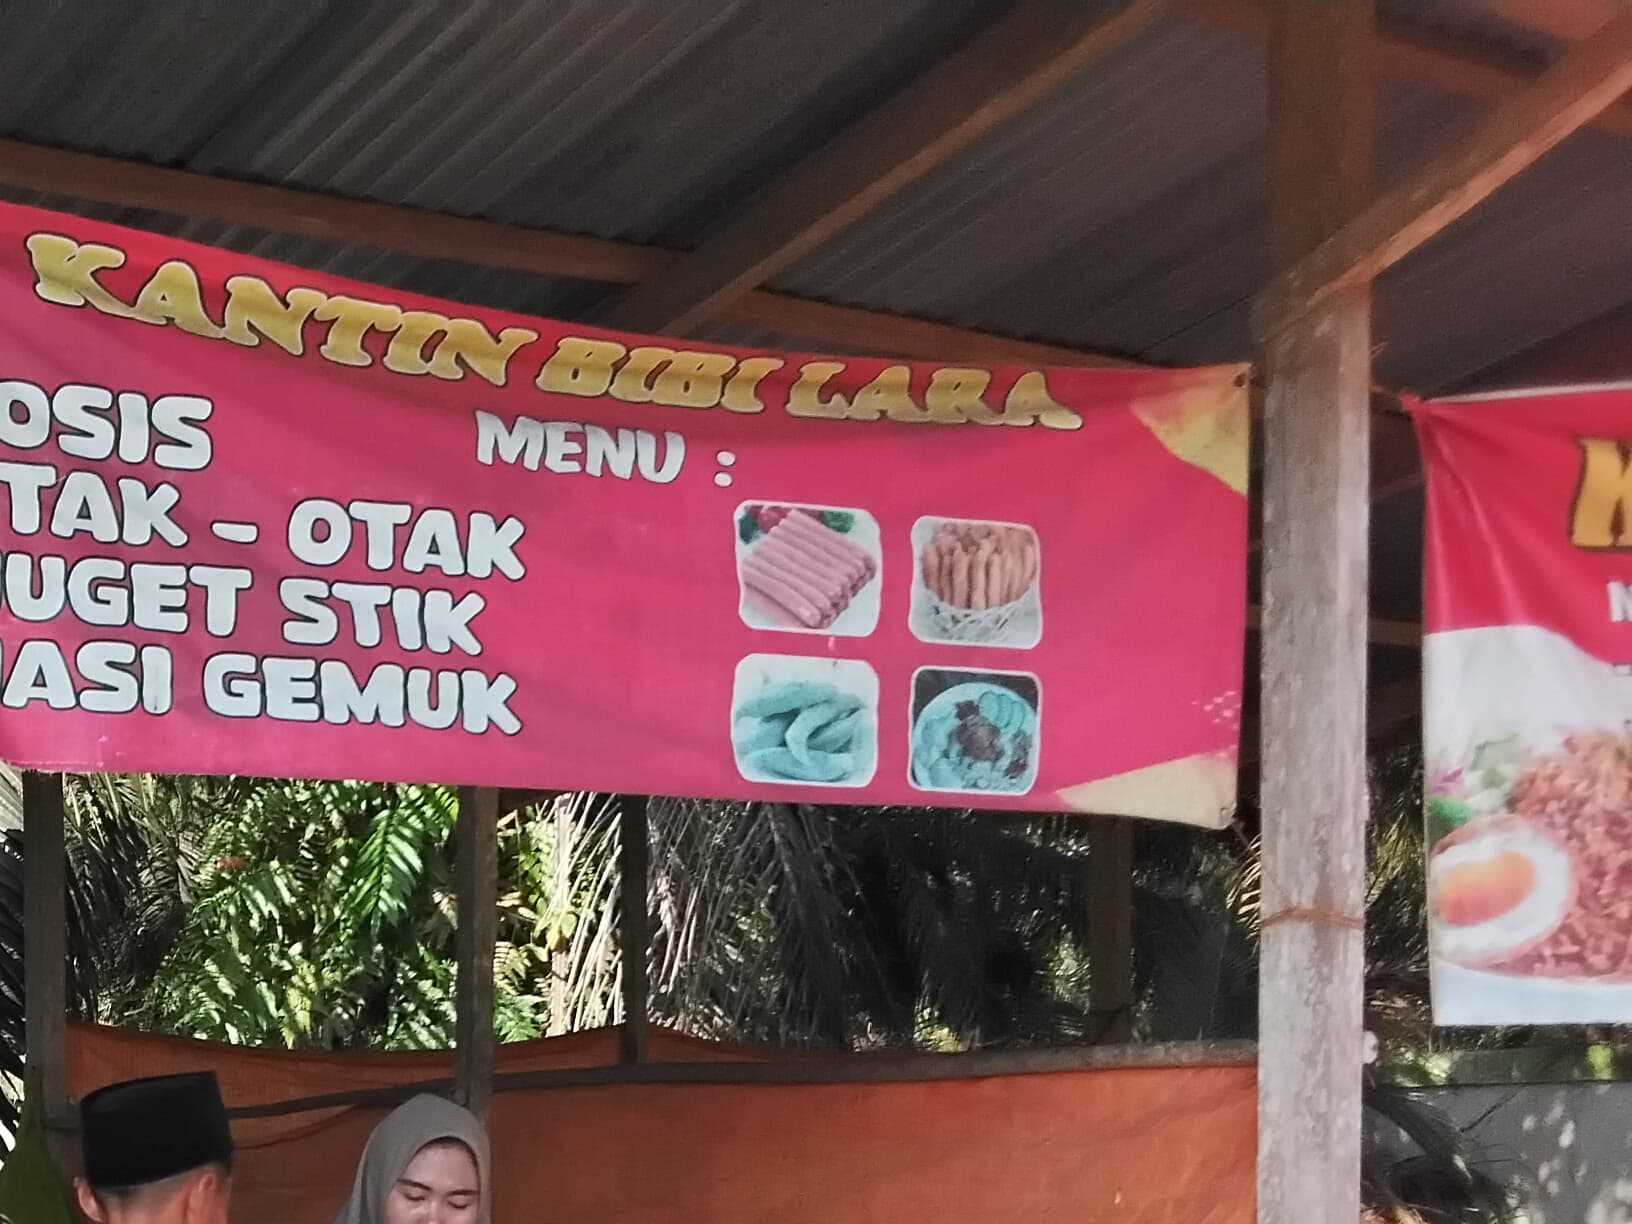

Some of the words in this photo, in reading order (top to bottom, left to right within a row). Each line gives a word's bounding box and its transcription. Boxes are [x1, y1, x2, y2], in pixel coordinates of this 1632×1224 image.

[25, 232, 537, 388] KANTIN
[534, 335, 783, 414] BIBI
[785, 359, 1085, 432] LARA
[474, 409, 687, 487] MENU
[287, 497, 527, 582] OTAK
[278, 577, 486, 657] STIK
[202, 652, 524, 736] GEMUK
